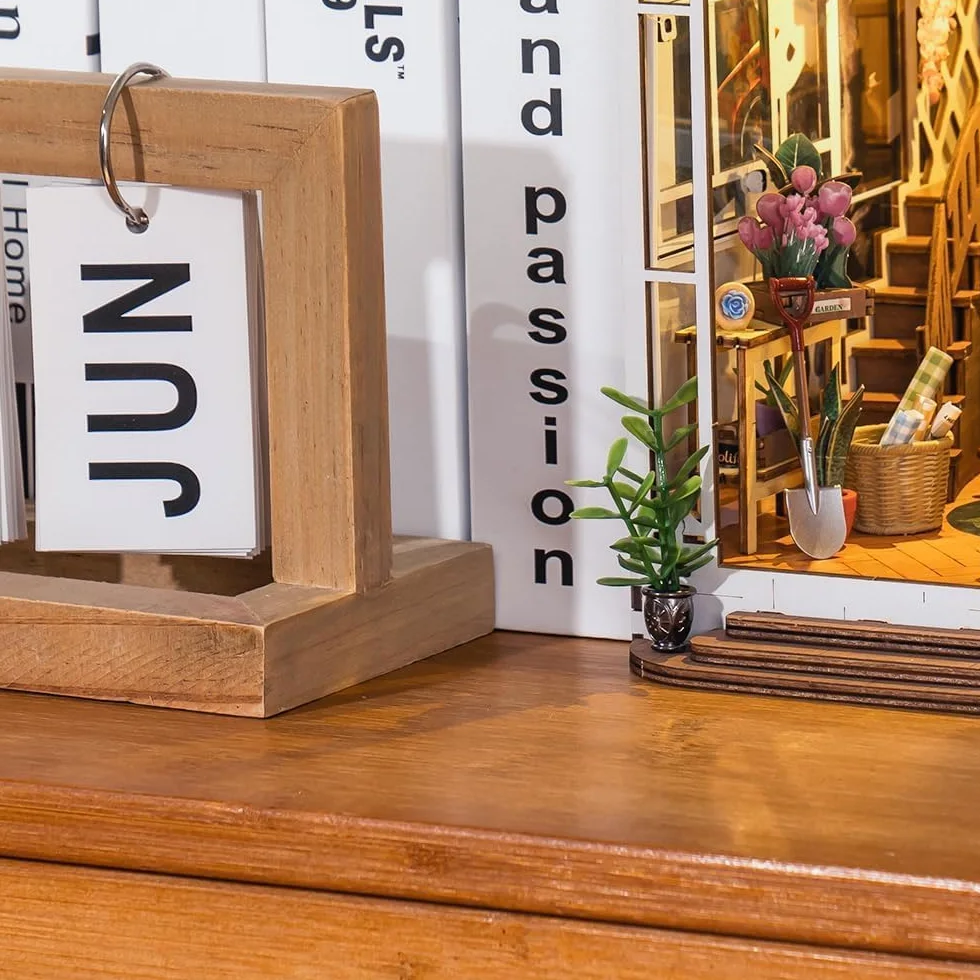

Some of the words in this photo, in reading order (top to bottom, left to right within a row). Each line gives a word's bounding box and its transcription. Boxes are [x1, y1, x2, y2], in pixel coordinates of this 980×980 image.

[3, 206, 29, 324] Home
[80, 262, 201, 518] JUN
[524, 185, 575, 587] passion
